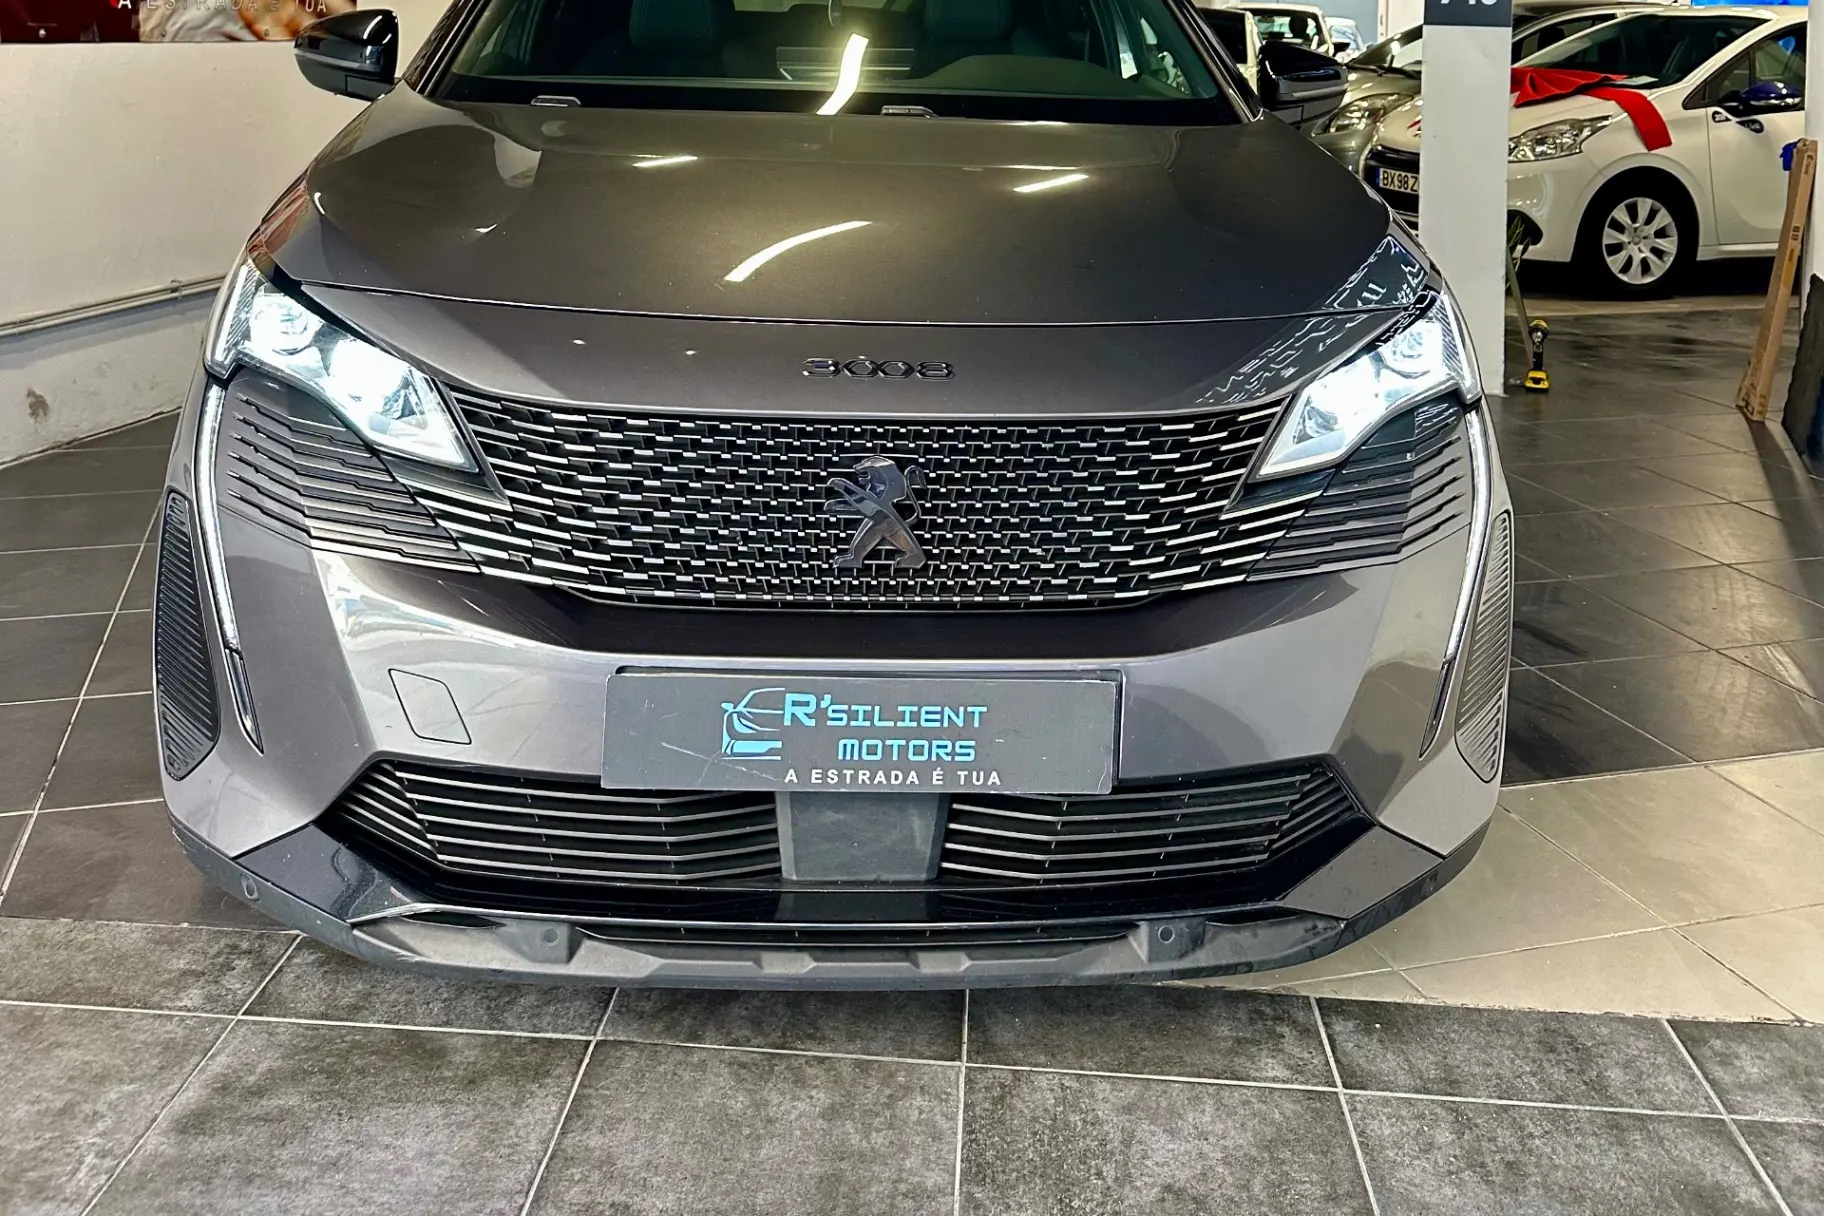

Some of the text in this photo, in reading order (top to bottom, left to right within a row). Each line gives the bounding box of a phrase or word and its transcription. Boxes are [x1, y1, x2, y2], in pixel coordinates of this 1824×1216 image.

[802, 357, 956, 381] 3008
[783, 693, 988, 728] R'SILIENT
[837, 739, 976, 762] MOTORS
[784, 767, 1001, 785] A ESTRADA É TUA
